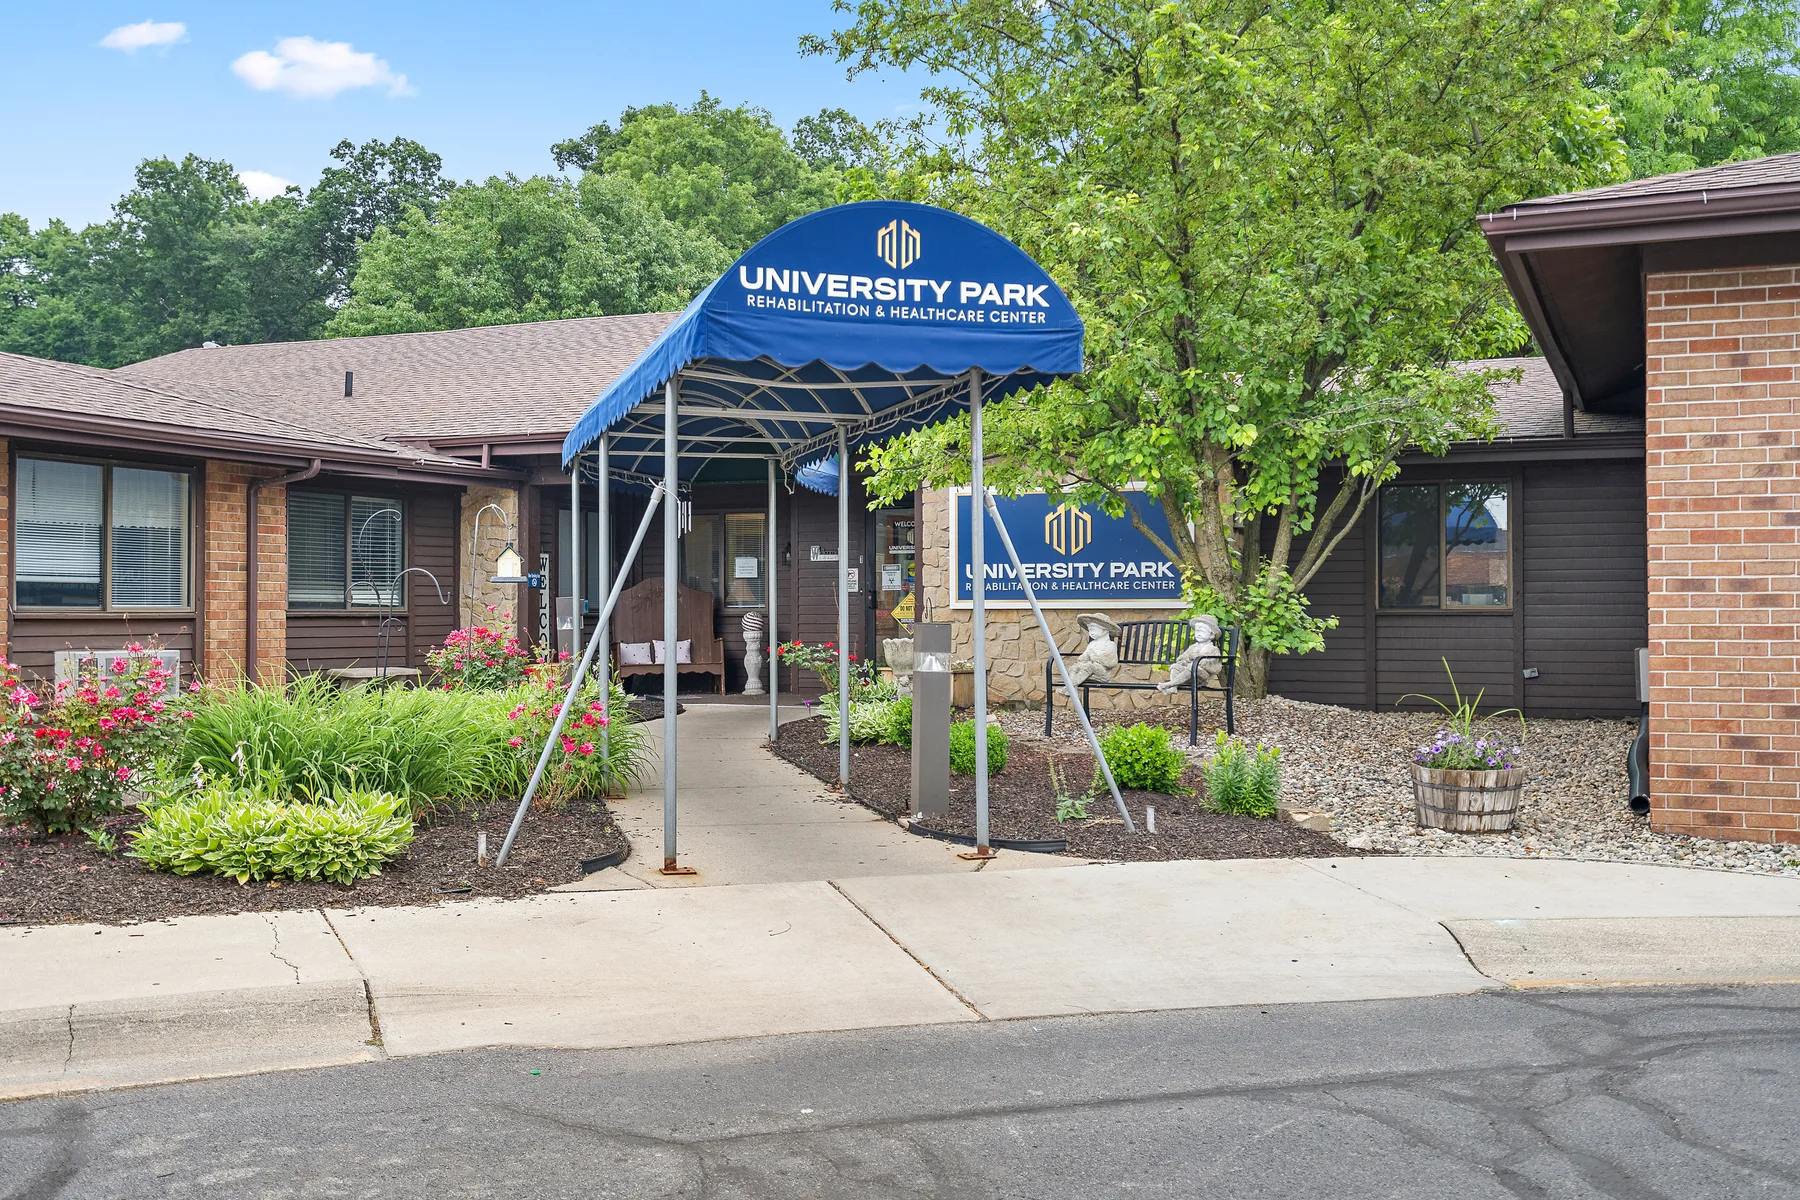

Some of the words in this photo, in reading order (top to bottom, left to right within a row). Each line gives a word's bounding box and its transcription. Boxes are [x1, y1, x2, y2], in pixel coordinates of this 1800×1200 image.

[739, 265, 952, 303] UNIVERSITY
[960, 281, 1050, 308] PARK
[747, 294, 871, 316] REHABILITATION
[875, 305, 885, 318] &
[890, 306, 985, 323] HEALTHCARE
[990, 310, 1046, 324] CENTER
[1110, 561, 1175, 578] PARK
[965, 581, 1048, 591] RABILITAION
[1051, 581, 1059, 591] &
[1062, 581, 1130, 591] HEALTHCARE
[1133, 580, 1176, 590] CENTER
